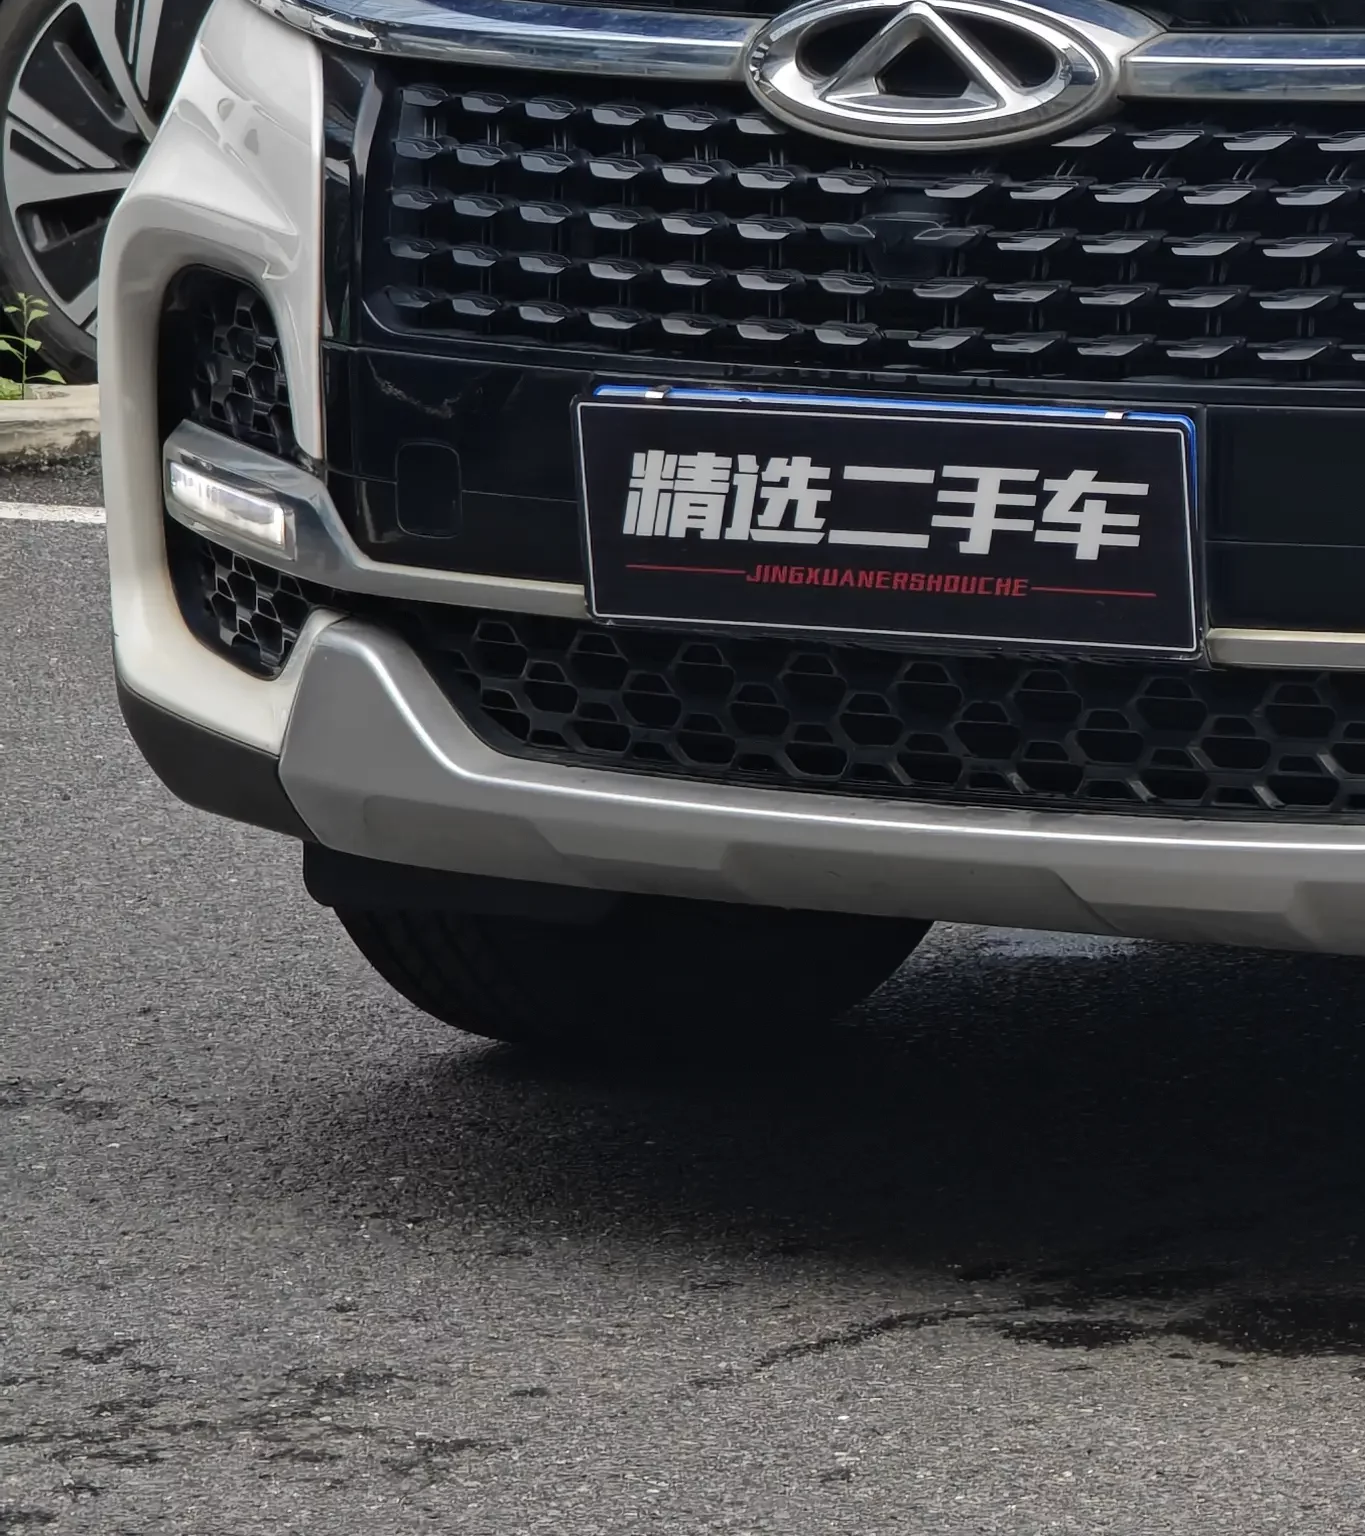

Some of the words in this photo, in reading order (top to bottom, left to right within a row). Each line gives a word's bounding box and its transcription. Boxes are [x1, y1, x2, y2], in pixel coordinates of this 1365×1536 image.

[622, 449, 1150, 561] 精选二手车
[745, 564, 1029, 597] JINGXUANERSHOUCHE
